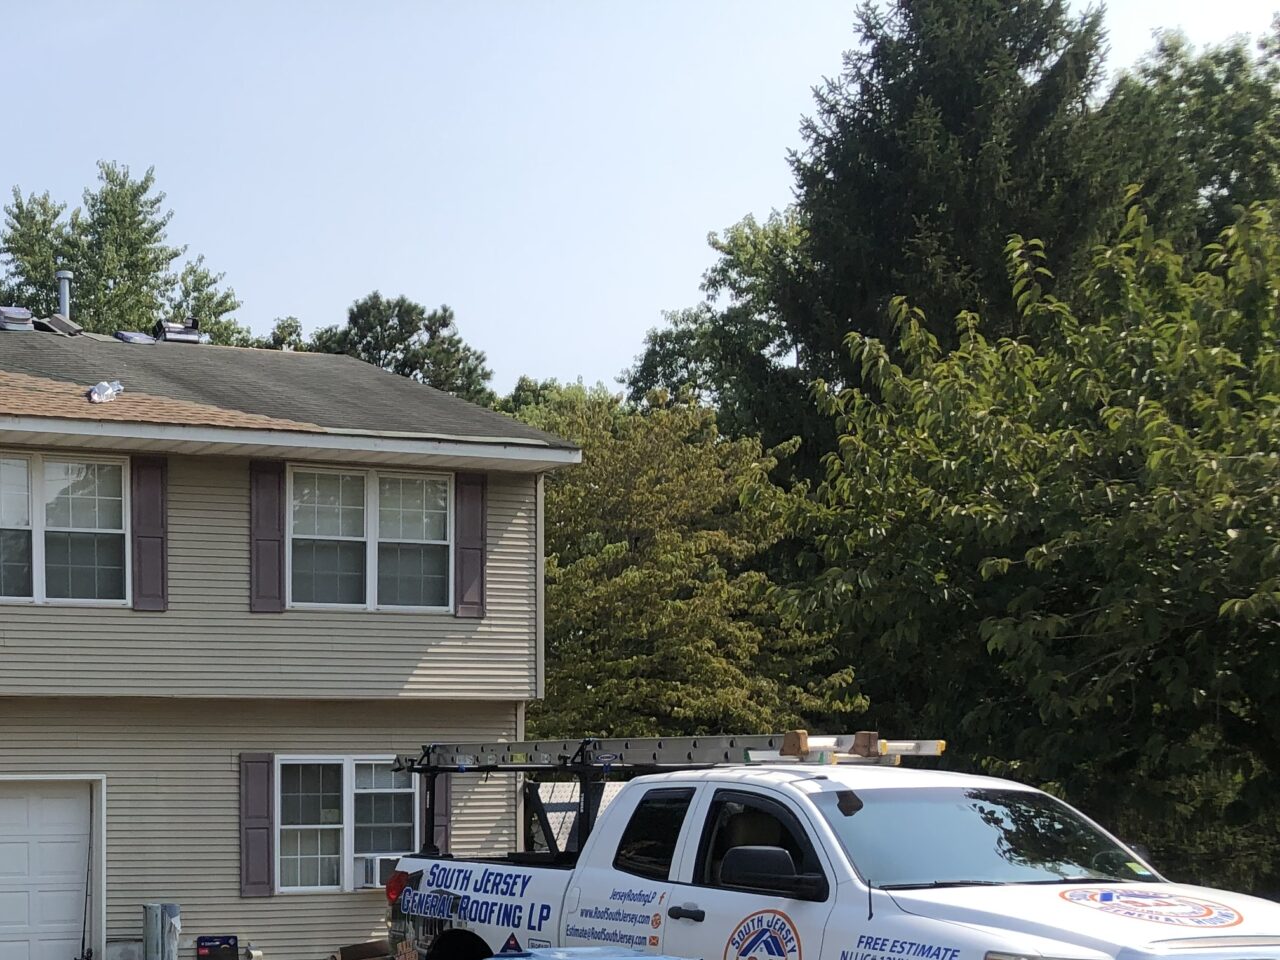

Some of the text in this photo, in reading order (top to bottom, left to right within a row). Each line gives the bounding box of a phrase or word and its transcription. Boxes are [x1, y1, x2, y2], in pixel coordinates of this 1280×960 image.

[427, 863, 532, 897] SOUTH JERSEY
[609, 888, 657, 906] JerseyRoofingLP
[401, 887, 551, 932] GENERAL ROOFING LP
[580, 907, 650, 926] www.RoofSouthJersey.com
[566, 924, 647, 948] Estimate@RoofSouthJersey.com
[732, 914, 796, 954] SOUTH JERSEY
[857, 935, 889, 952] FREE
